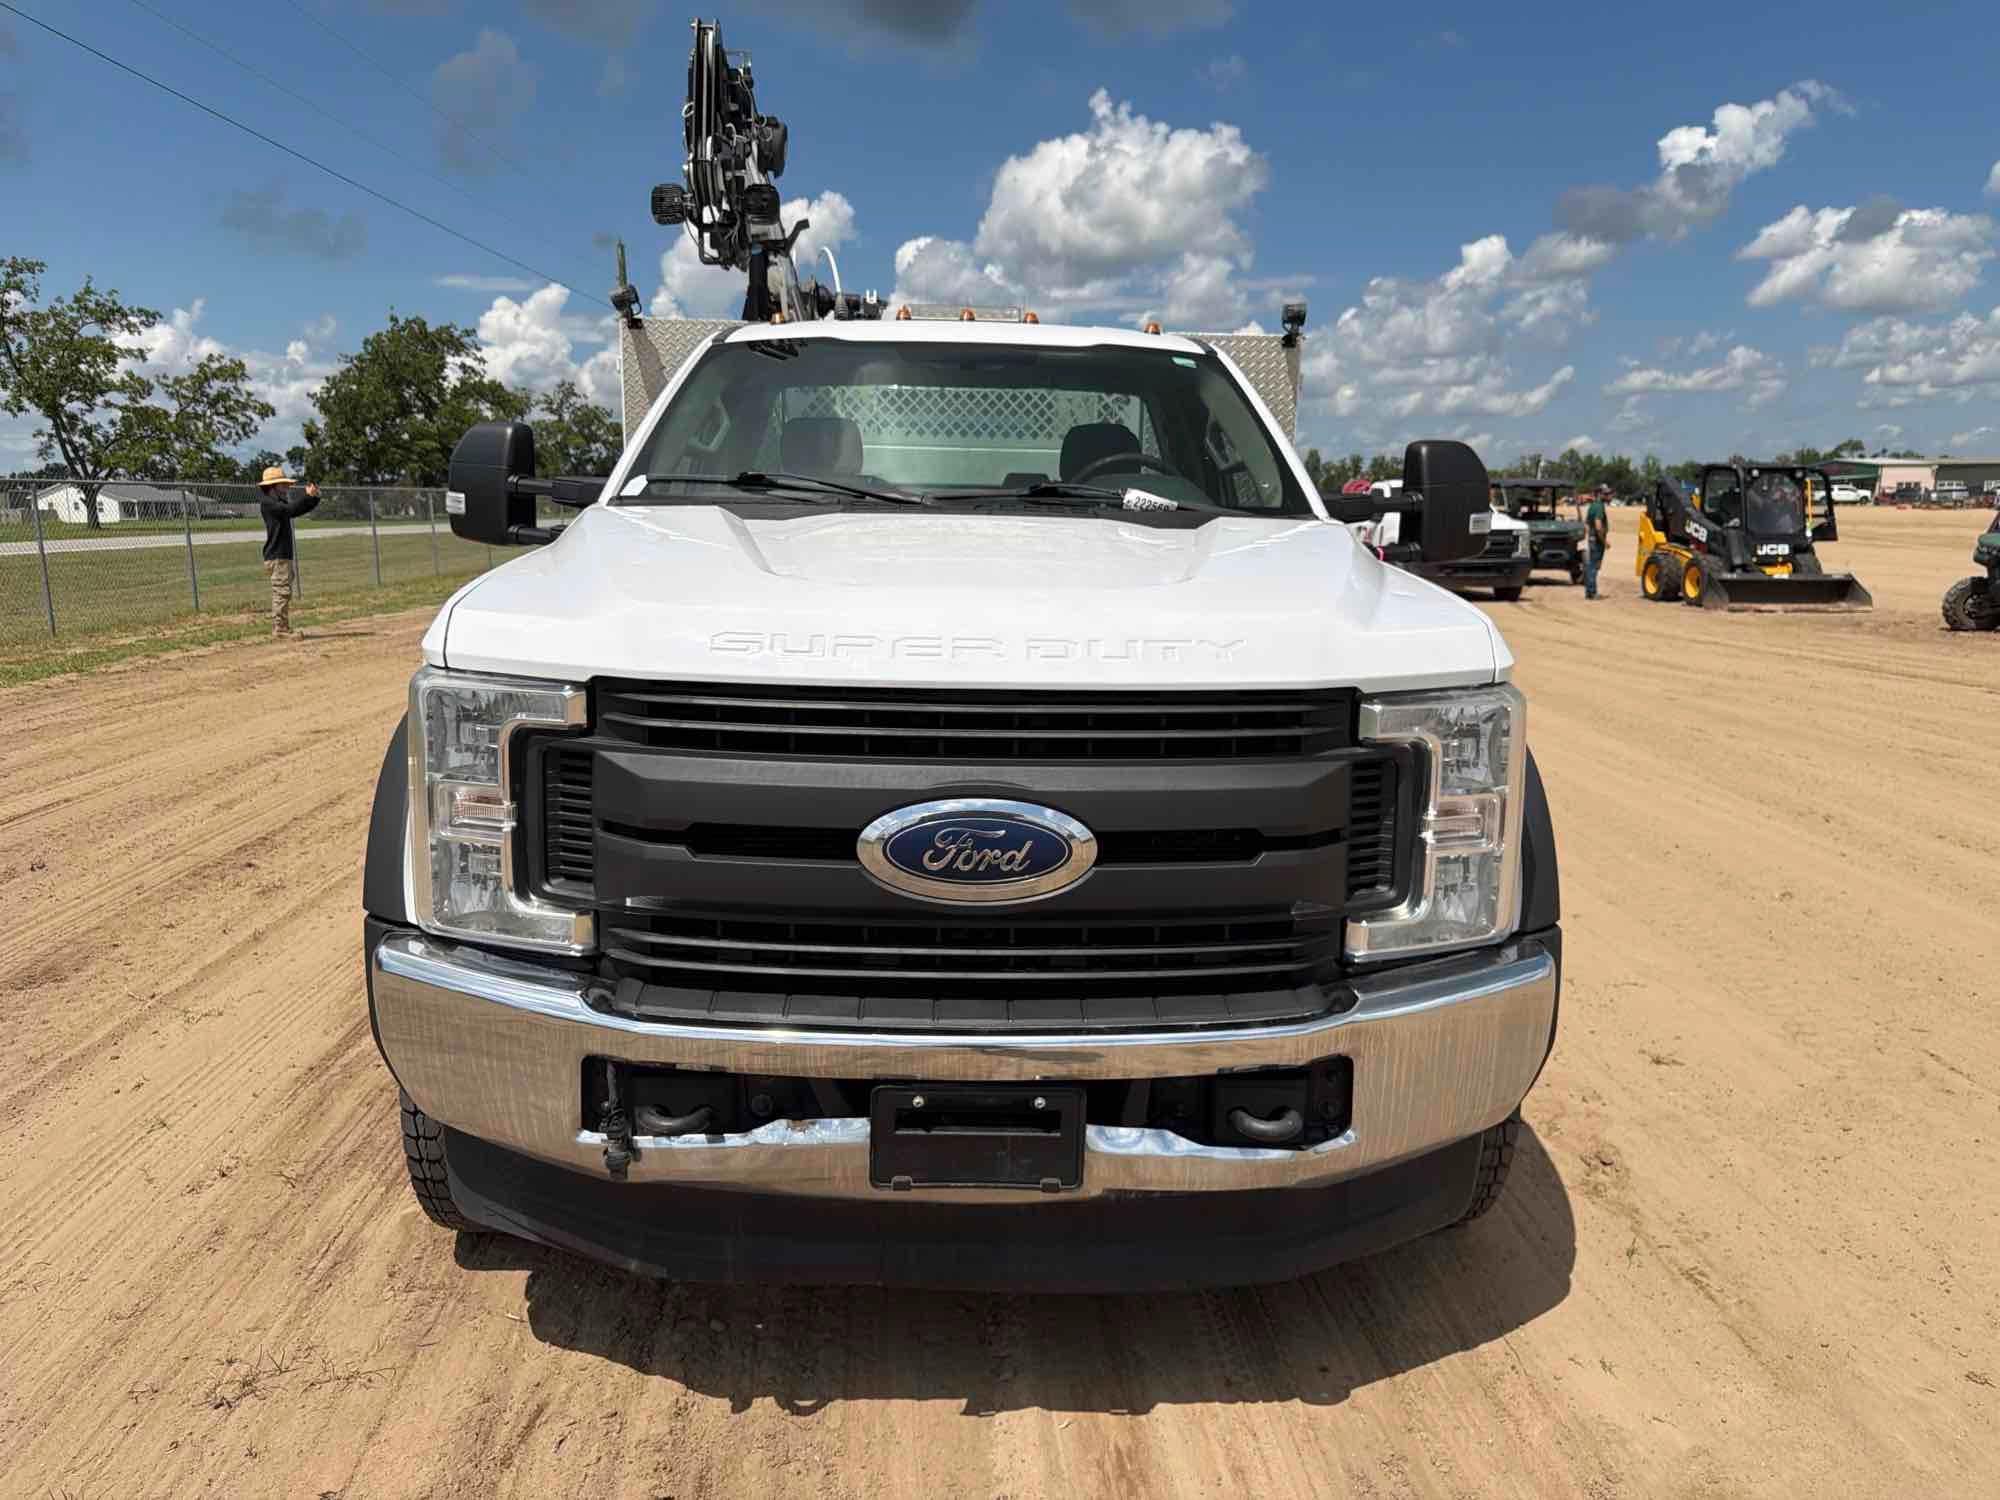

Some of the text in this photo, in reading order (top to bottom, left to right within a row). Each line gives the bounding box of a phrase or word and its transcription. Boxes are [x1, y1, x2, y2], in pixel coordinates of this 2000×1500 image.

[1685, 519, 1708, 543] JCB
[1756, 544, 1789, 555] JCB
[708, 630, 1248, 663] SUPER DUTY
[922, 827, 1033, 872] Ford
